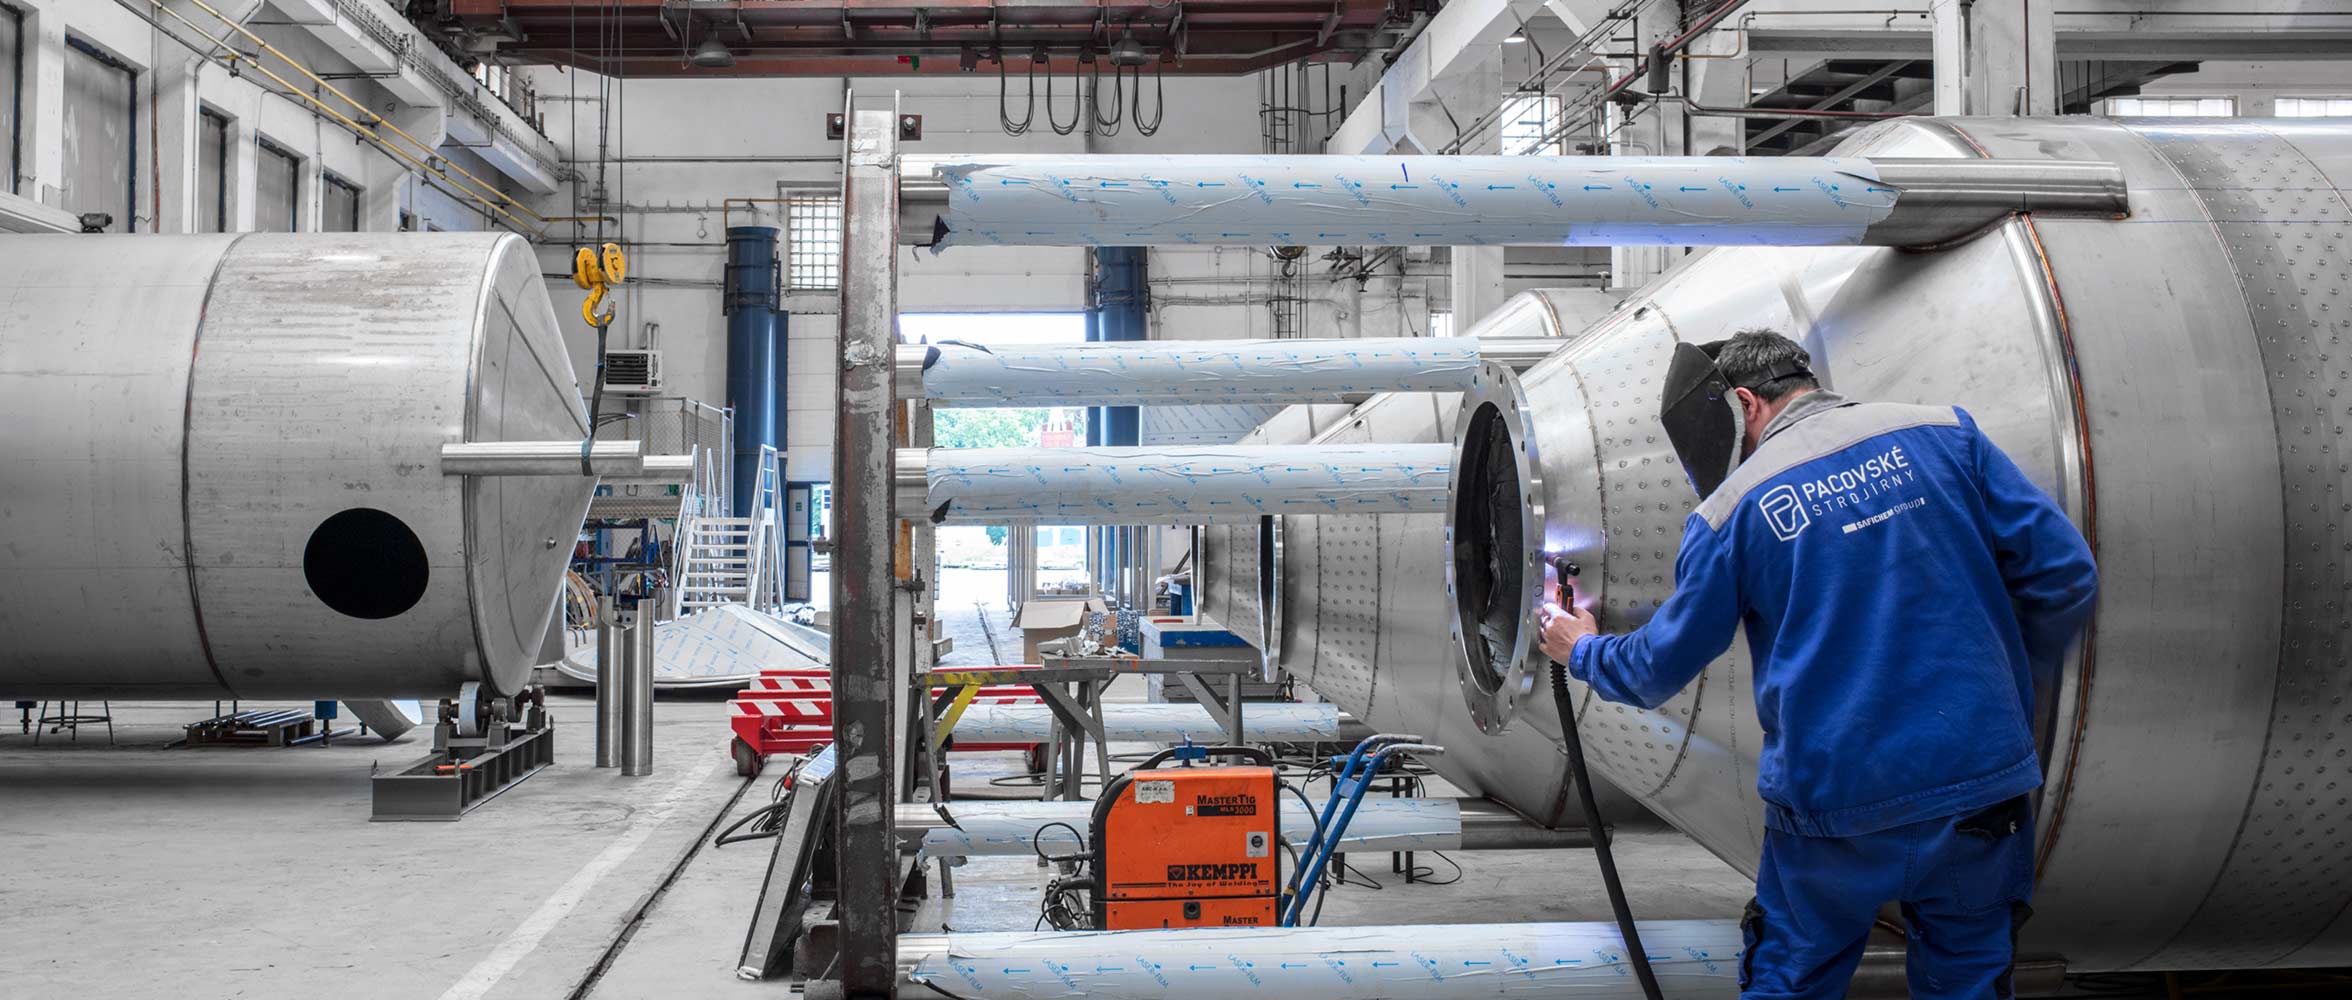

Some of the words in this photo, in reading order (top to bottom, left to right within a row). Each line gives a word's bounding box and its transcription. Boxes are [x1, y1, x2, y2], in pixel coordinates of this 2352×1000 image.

[1238, 172, 1273, 206] LASER-FILM
[1335, 172, 1370, 207] LASER-FILM
[1431, 173, 1466, 208] LASER-FILM
[1528, 174, 1563, 209] LASER-FILM
[1624, 175, 1659, 209] LASER-FILM
[1718, 176, 1753, 209] LASER-FILM
[1802, 446, 1909, 502] PACOVSKÉ
[1234, 806, 1255, 815] 3000
[1186, 863, 1257, 880] KEMPPI
[1223, 915, 1258, 925] MASTER
[1043, 957, 1077, 990] LASER-FILM
[1136, 953, 1169, 989] LASER-FILM
[1227, 953, 1261, 987] LASER-FILM
[1411, 950, 1444, 984] LASER-FILM
